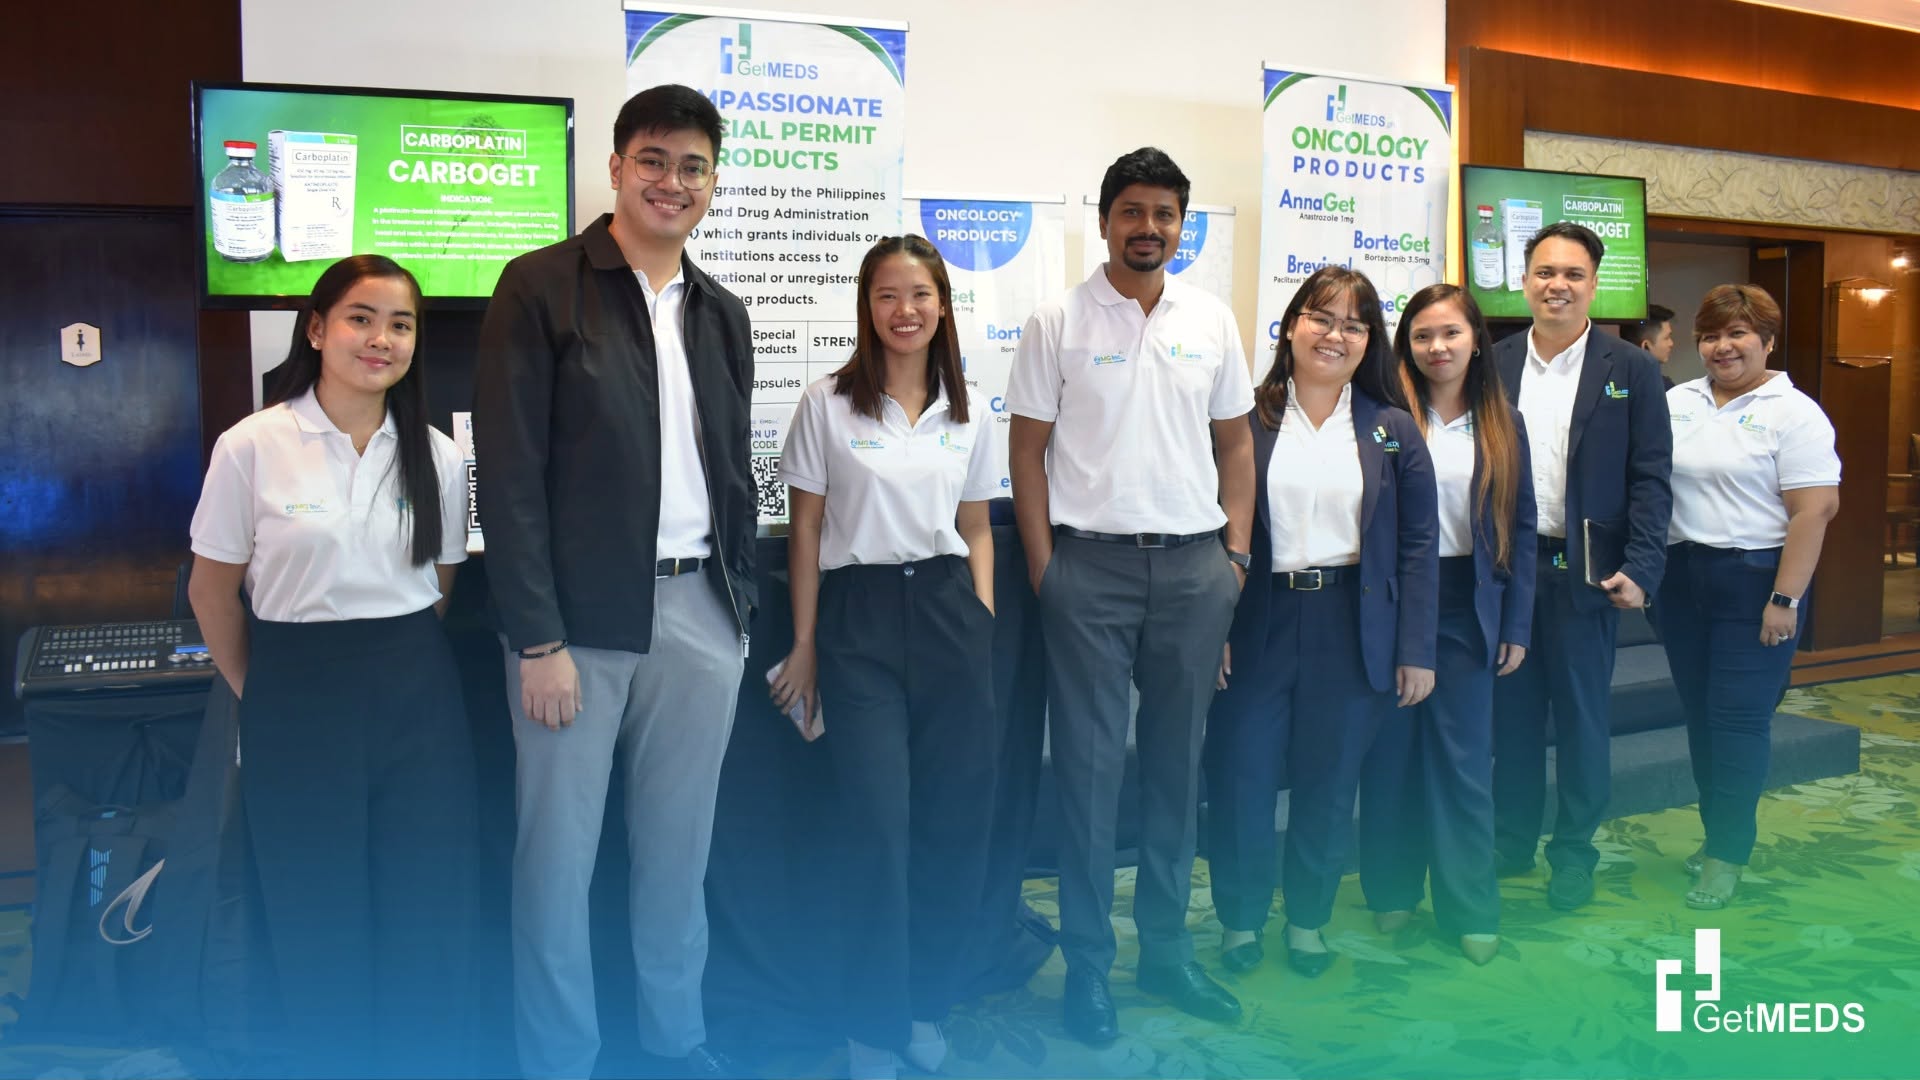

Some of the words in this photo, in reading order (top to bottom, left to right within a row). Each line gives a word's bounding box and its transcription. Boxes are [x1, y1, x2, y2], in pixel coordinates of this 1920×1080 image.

[737, 60, 819, 80] GetMEDS
[698, 89, 883, 118] MPASSIONATE
[721, 119, 773, 140] CIAL
[781, 122, 877, 145] PERMIT
[404, 133, 522, 151] CARBOPLATIN
[1291, 126, 1429, 160] ONCOLOGY
[295, 151, 349, 163] Carboplatin
[717, 147, 839, 171] RODUCTS
[388, 159, 541, 187] CARBOGET
[1293, 156, 1425, 184] PRODUCTS
[714, 186, 767, 199] granted
[771, 186, 787, 199] by
[791, 187, 812, 198] the
[816, 187, 886, 200] Philippines
[1279, 189, 1356, 214] AnnaGet
[1565, 200, 1622, 214] CARBOPLATIN
[707, 206, 733, 217] and
[737, 207, 769, 220] Drug
[774, 208, 869, 221] Administration
[935, 208, 1018, 222] ONCOLOGY
[1299, 212, 1339, 222] Anastrozole
[1341, 215, 1354, 225] 1mg
[703, 229, 743, 240] which
[747, 230, 788, 243] grants
[792, 230, 861, 242] individuals
[865, 233, 879, 242] or
[937, 229, 1018, 242] PRODUCTS
[1354, 230, 1430, 253] BorteGet
[700, 250, 775, 262] institutions
[778, 253, 821, 262] access
[825, 252, 839, 263] to
[1364, 253, 1406, 263] Bortezomib
[1407, 256, 1430, 266] 3.5mg
[770, 274, 785, 284] or
[787, 273, 860, 286] unregistere
[757, 295, 818, 306] products.
[752, 329, 796, 342] Special
[986, 324, 1022, 341] Bort
[753, 344, 797, 354] roducts
[813, 336, 856, 347] STREN
[752, 377, 801, 391] apsules
[764, 430, 778, 438] UP
[752, 440, 778, 449] CODE
